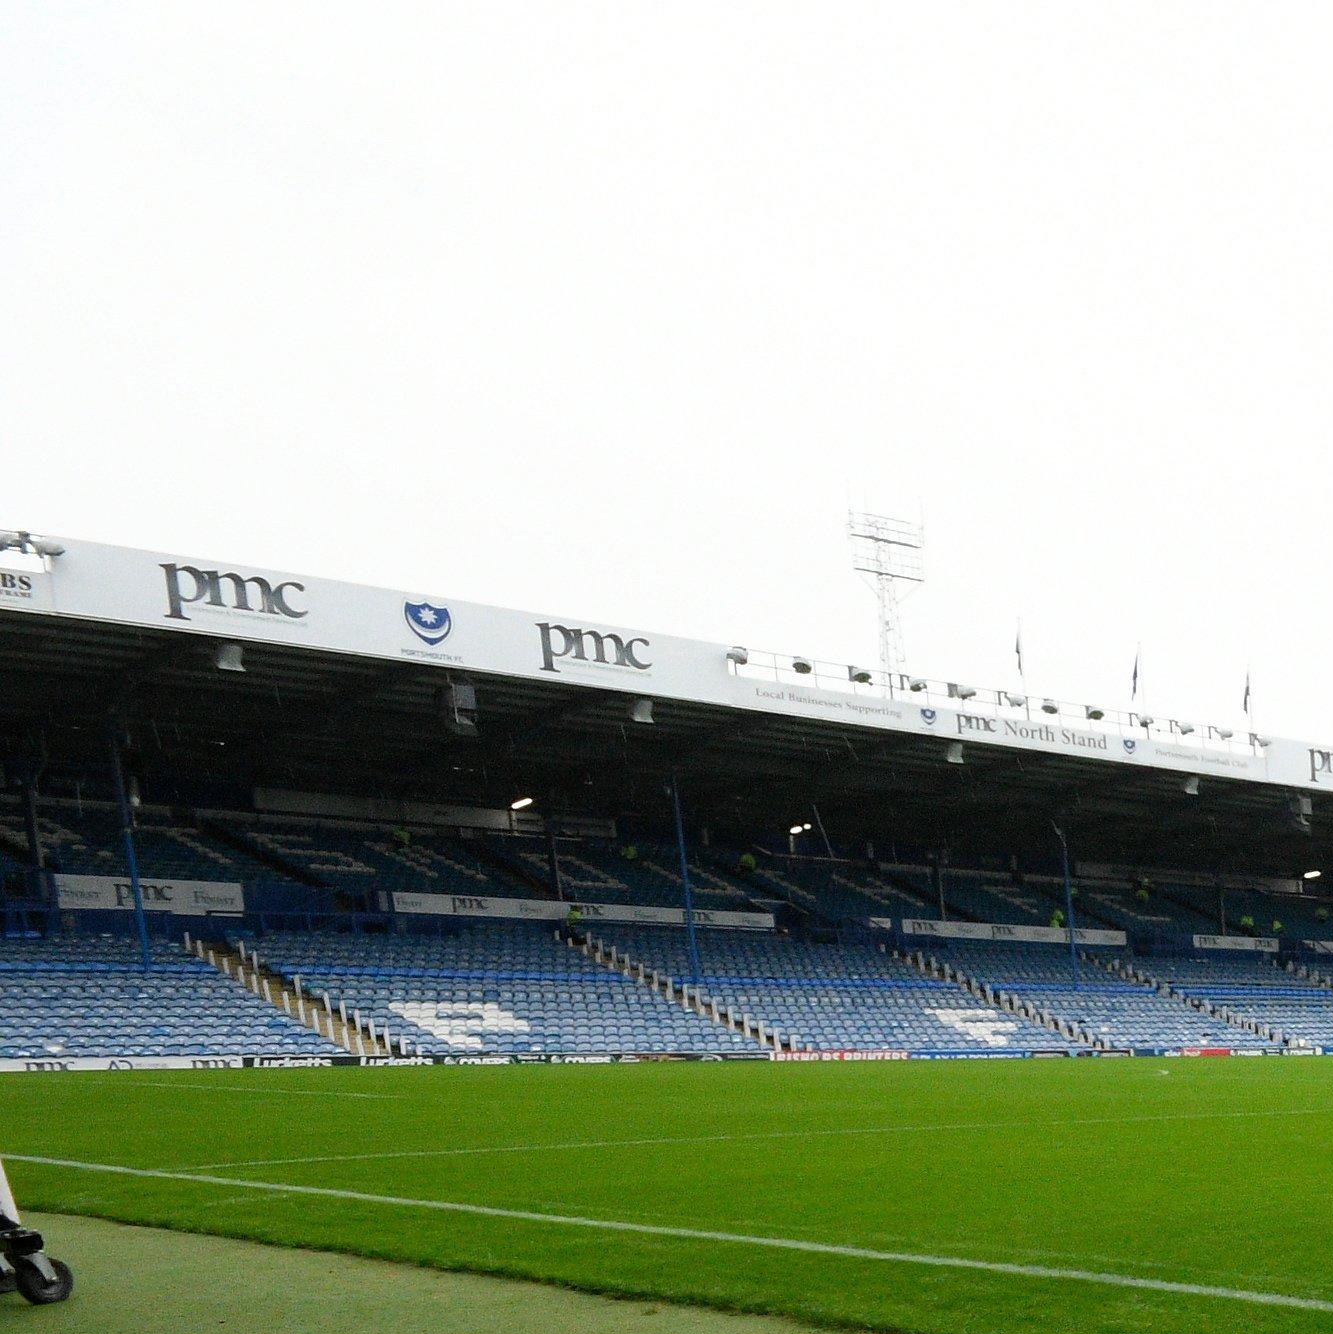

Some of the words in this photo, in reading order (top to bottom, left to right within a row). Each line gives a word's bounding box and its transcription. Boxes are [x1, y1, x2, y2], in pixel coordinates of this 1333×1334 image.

[158, 563, 309, 620] pmc
[401, 648, 452, 661] PORTSMOUTH
[536, 622, 653, 673] pmc
[755, 688, 784, 700] Local
[789, 693, 843, 709] Businesses
[847, 703, 902, 718] Supporting
[957, 713, 996, 734] pmc
[1004, 721, 1055, 742] North
[1062, 730, 1107, 750] Stand
[113, 883, 174, 906] pmc
[451, 896, 488, 913] pmc
